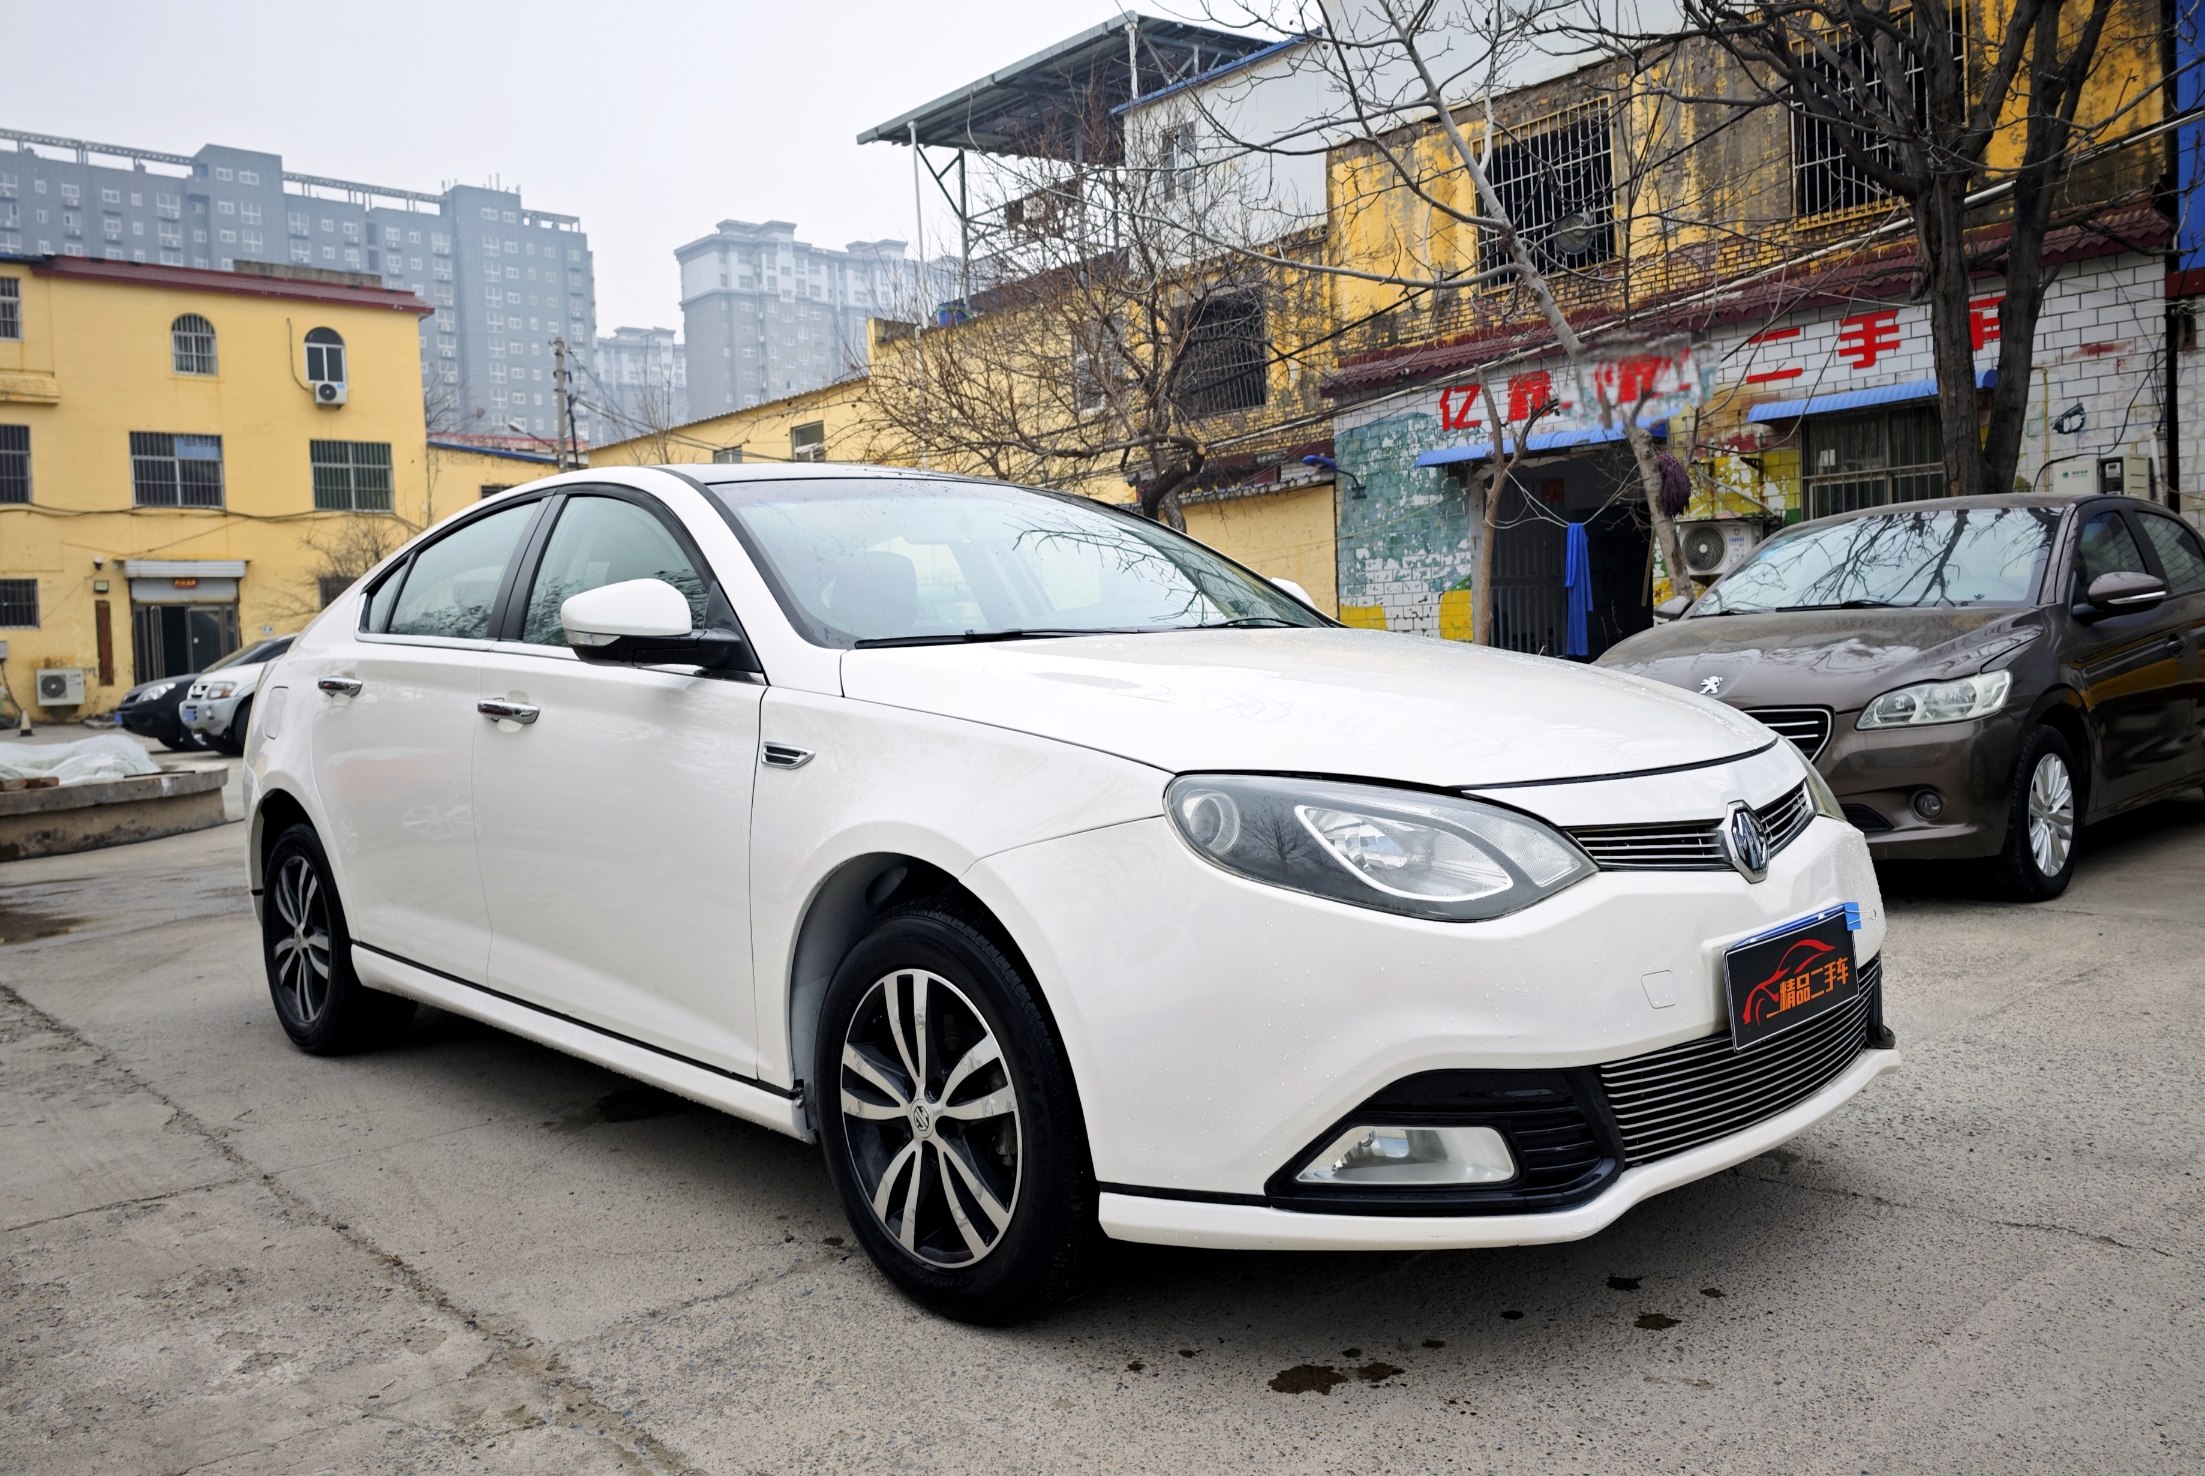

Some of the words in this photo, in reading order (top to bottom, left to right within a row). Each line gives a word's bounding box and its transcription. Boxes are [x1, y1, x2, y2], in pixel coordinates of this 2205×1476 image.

[1774, 957, 1849, 1014] 精品二手车
